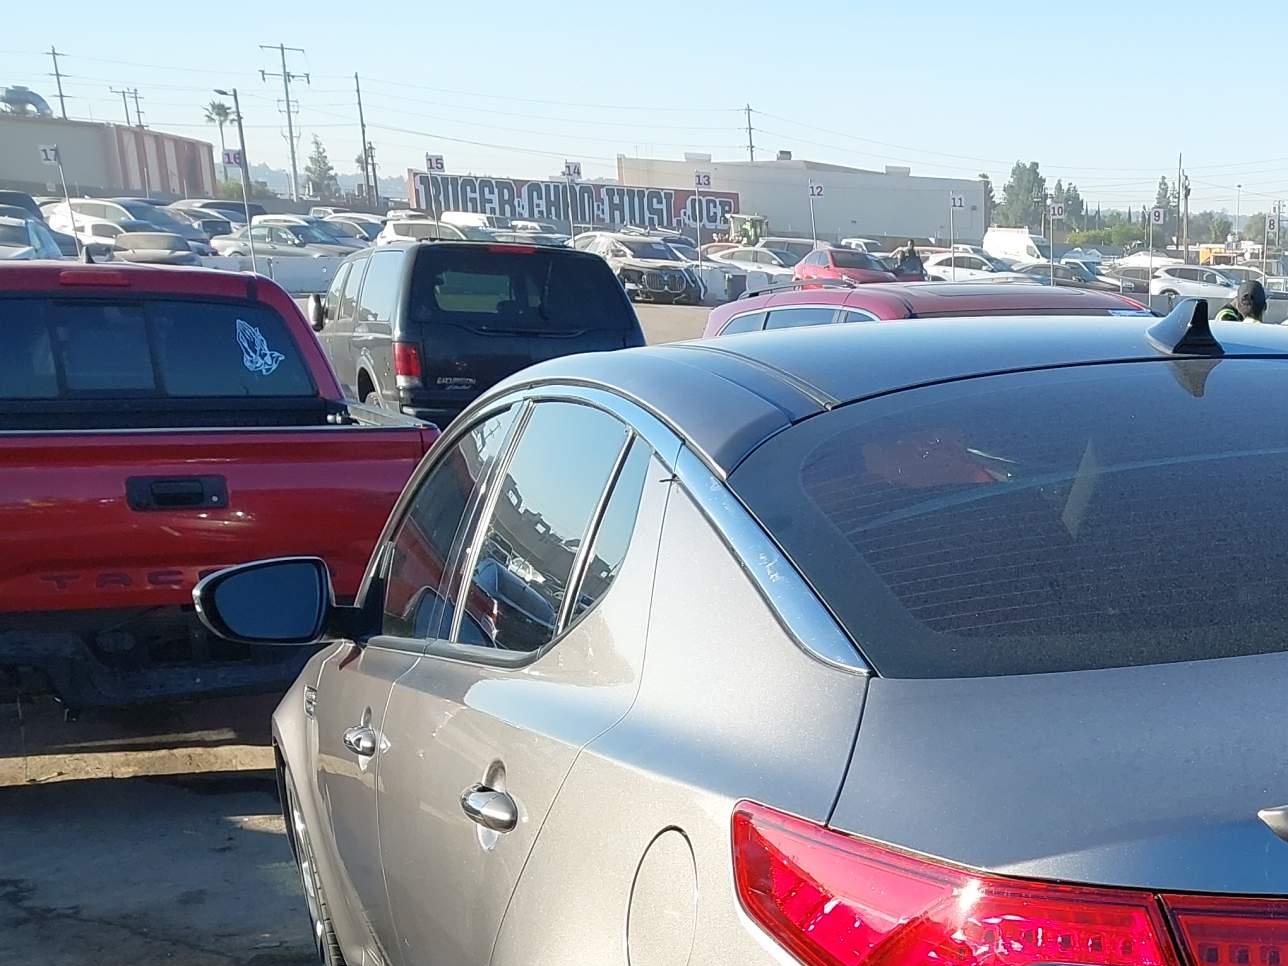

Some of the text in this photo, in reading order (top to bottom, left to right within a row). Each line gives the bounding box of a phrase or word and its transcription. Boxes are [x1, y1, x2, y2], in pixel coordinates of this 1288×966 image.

[42, 148, 57, 161] 17
[225, 152, 241, 166] 16
[427, 158, 444, 170] 15
[566, 165, 581, 176] 14
[695, 174, 711, 186] 13
[809, 186, 823, 197] 12
[951, 197, 965, 208] 11
[1052, 206, 1064, 217] 10
[1153, 210, 1161, 222] 9
[1268, 219, 1275, 231] 8
